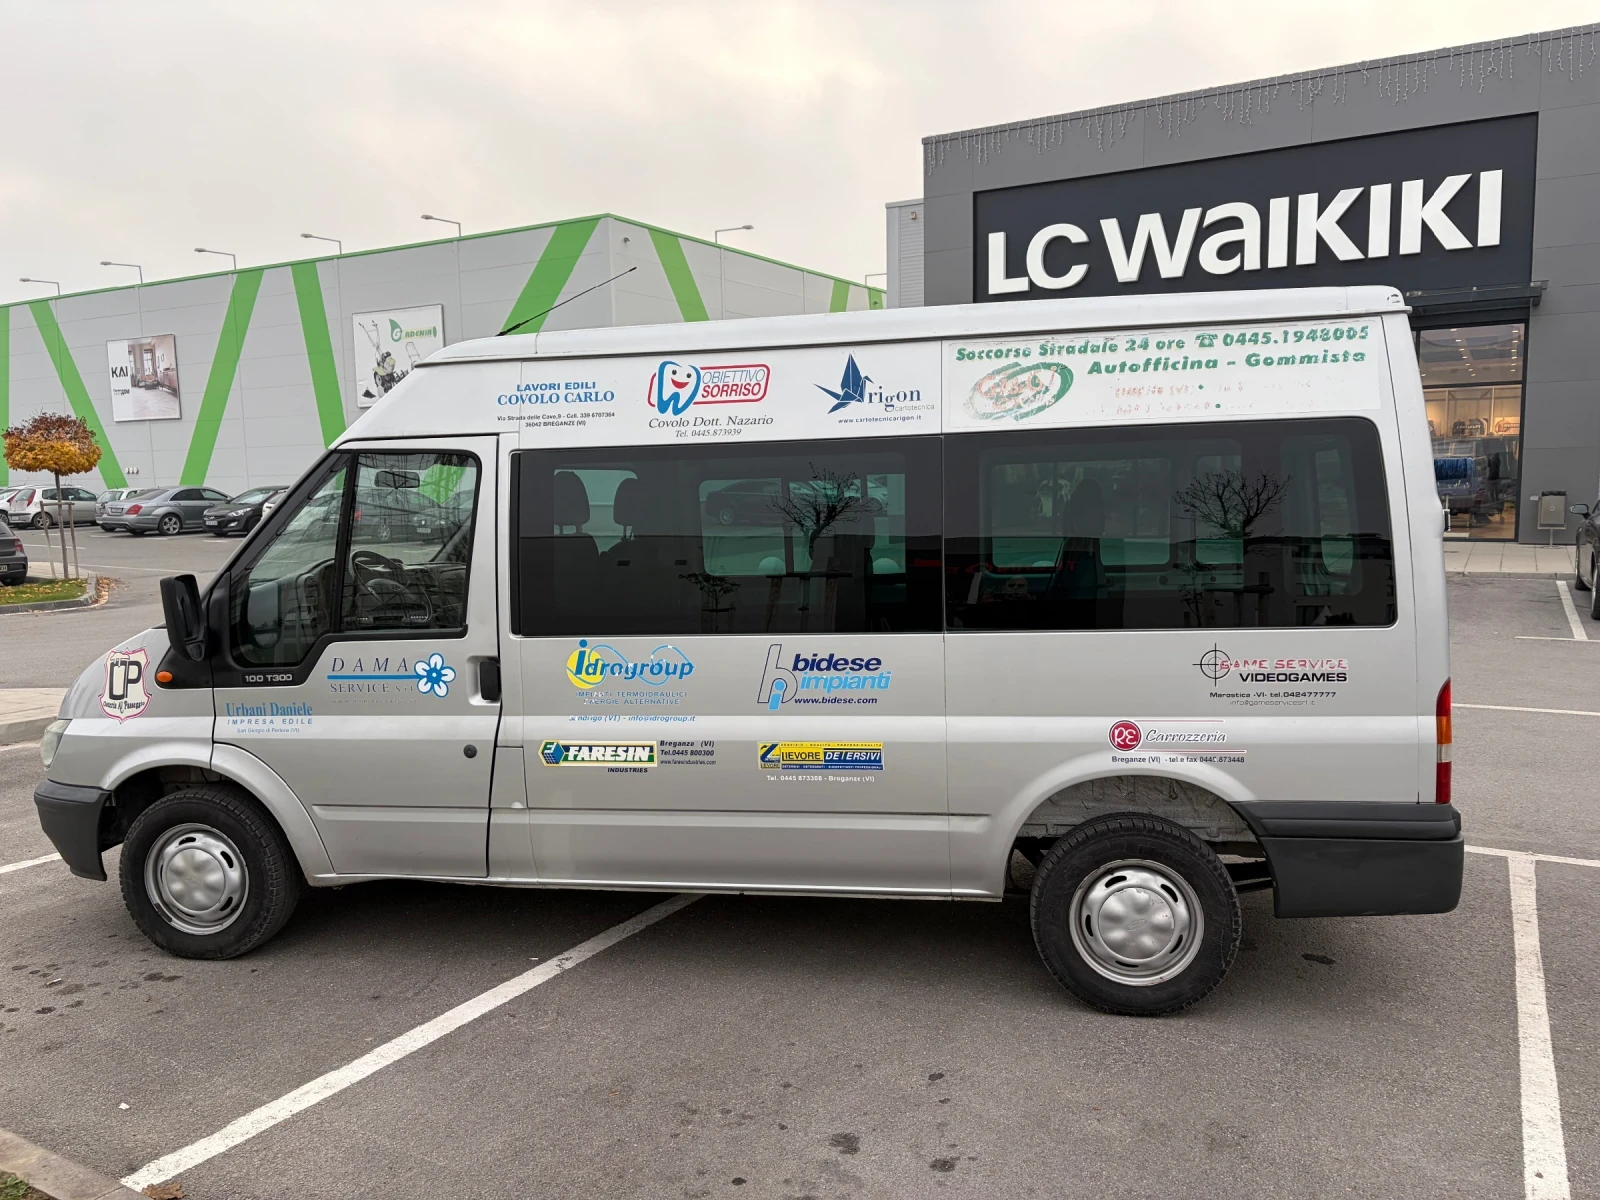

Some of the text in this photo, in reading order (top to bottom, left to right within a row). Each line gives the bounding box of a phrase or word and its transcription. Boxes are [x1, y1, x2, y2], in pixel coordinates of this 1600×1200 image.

[988, 223, 1089, 296] LC
[956, 347, 1032, 362] Soccorso
[1038, 340, 1118, 356] Stradale
[1125, 337, 1150, 352] 24
[1156, 338, 1186, 350] ore
[1087, 355, 1218, 374] Autofficina
[1245, 350, 1366, 367] Gommista
[702, 369, 766, 384] OBIETTIVO
[516, 382, 596, 392] LAVORI EDILI
[702, 383, 761, 398] SORRISO
[498, 390, 614, 405] COVOLO CARLO
[894, 404, 934, 412] cartotecnica
[648, 415, 774, 428] Covolo Dott. Nazario
[838, 414, 922, 424] www.cartotecnicarigon.it
[675, 428, 742, 438] Tel. 0445.873939
[332, 658, 408, 672] DAMA
[792, 653, 882, 672] bidese
[245, 674, 292, 682] 100 T300
[800, 671, 892, 694] impianti
[1239, 672, 1348, 682] VIDEOGAMES
[330, 684, 390, 692] SERVICE
[226, 702, 312, 717] Urbani Daniele
[604, 714, 621, 722] (VI)
[628, 714, 696, 722] info@idrogroup.it
[1146, 730, 1227, 742] Carrozzeria
[567, 746, 650, 762] FARESIN
